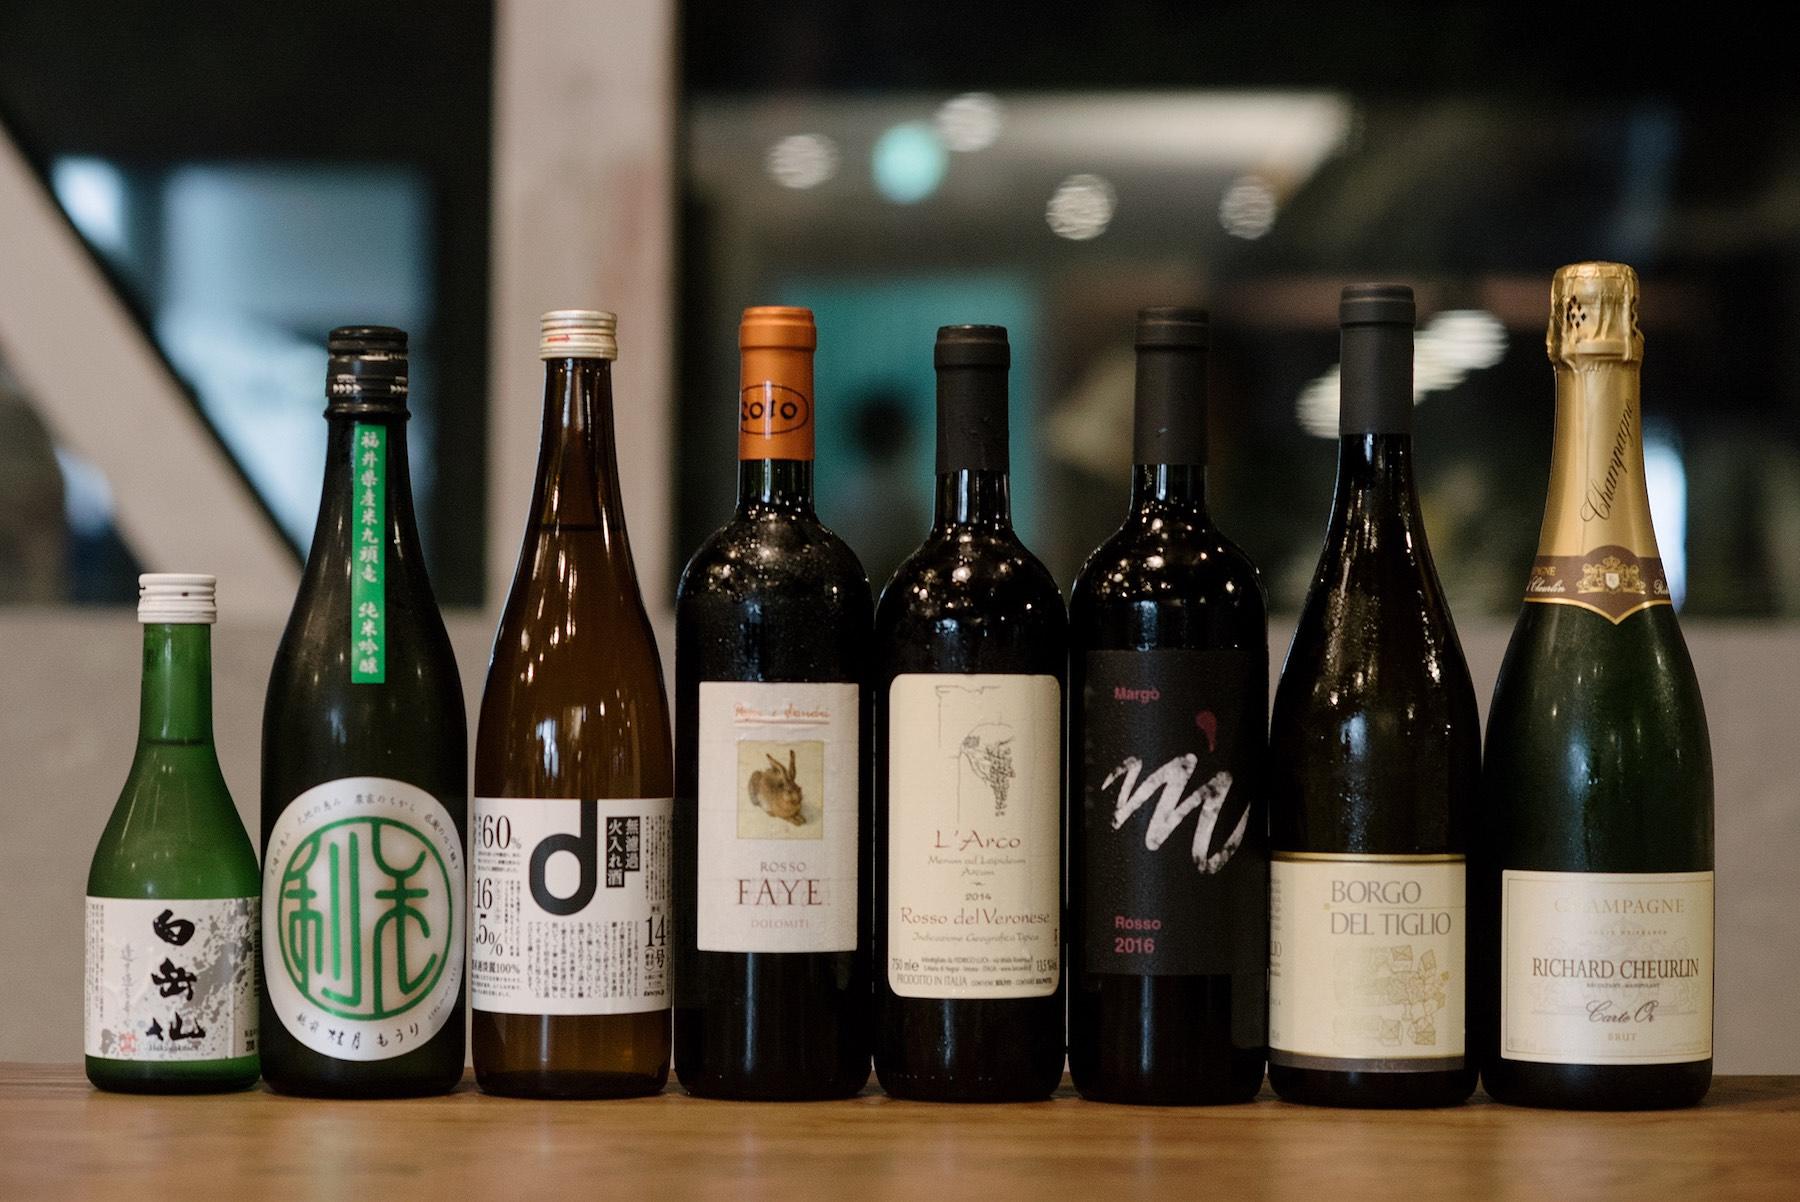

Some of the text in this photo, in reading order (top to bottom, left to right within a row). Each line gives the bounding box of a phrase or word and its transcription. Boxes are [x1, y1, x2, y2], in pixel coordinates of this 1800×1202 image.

[1580, 399, 1634, 523] Champagne
[358, 601, 379, 674] 純米吟醸
[935, 829, 1021, 851] L'Arco
[608, 818, 623, 886] 火入れ酒
[760, 861, 807, 873] ROSSO
[737, 878, 822, 906] FAYE
[1331, 880, 1421, 904] BORGO
[901, 907, 1050, 925] Rosso del Veronese
[1554, 899, 1684, 915] CAMPAGNE
[751, 918, 810, 929] DOLOMITI
[1115, 916, 1161, 930] Rosso
[1331, 912, 1450, 936] DEL TIGLIO
[1115, 938, 1155, 954] 2016
[147, 908, 206, 1041] 白岳仙
[1532, 957, 1699, 979] RICHARD CHEURLIN
[1586, 1000, 1631, 1023] Carte
[377, 1022, 419, 1048] もうり
